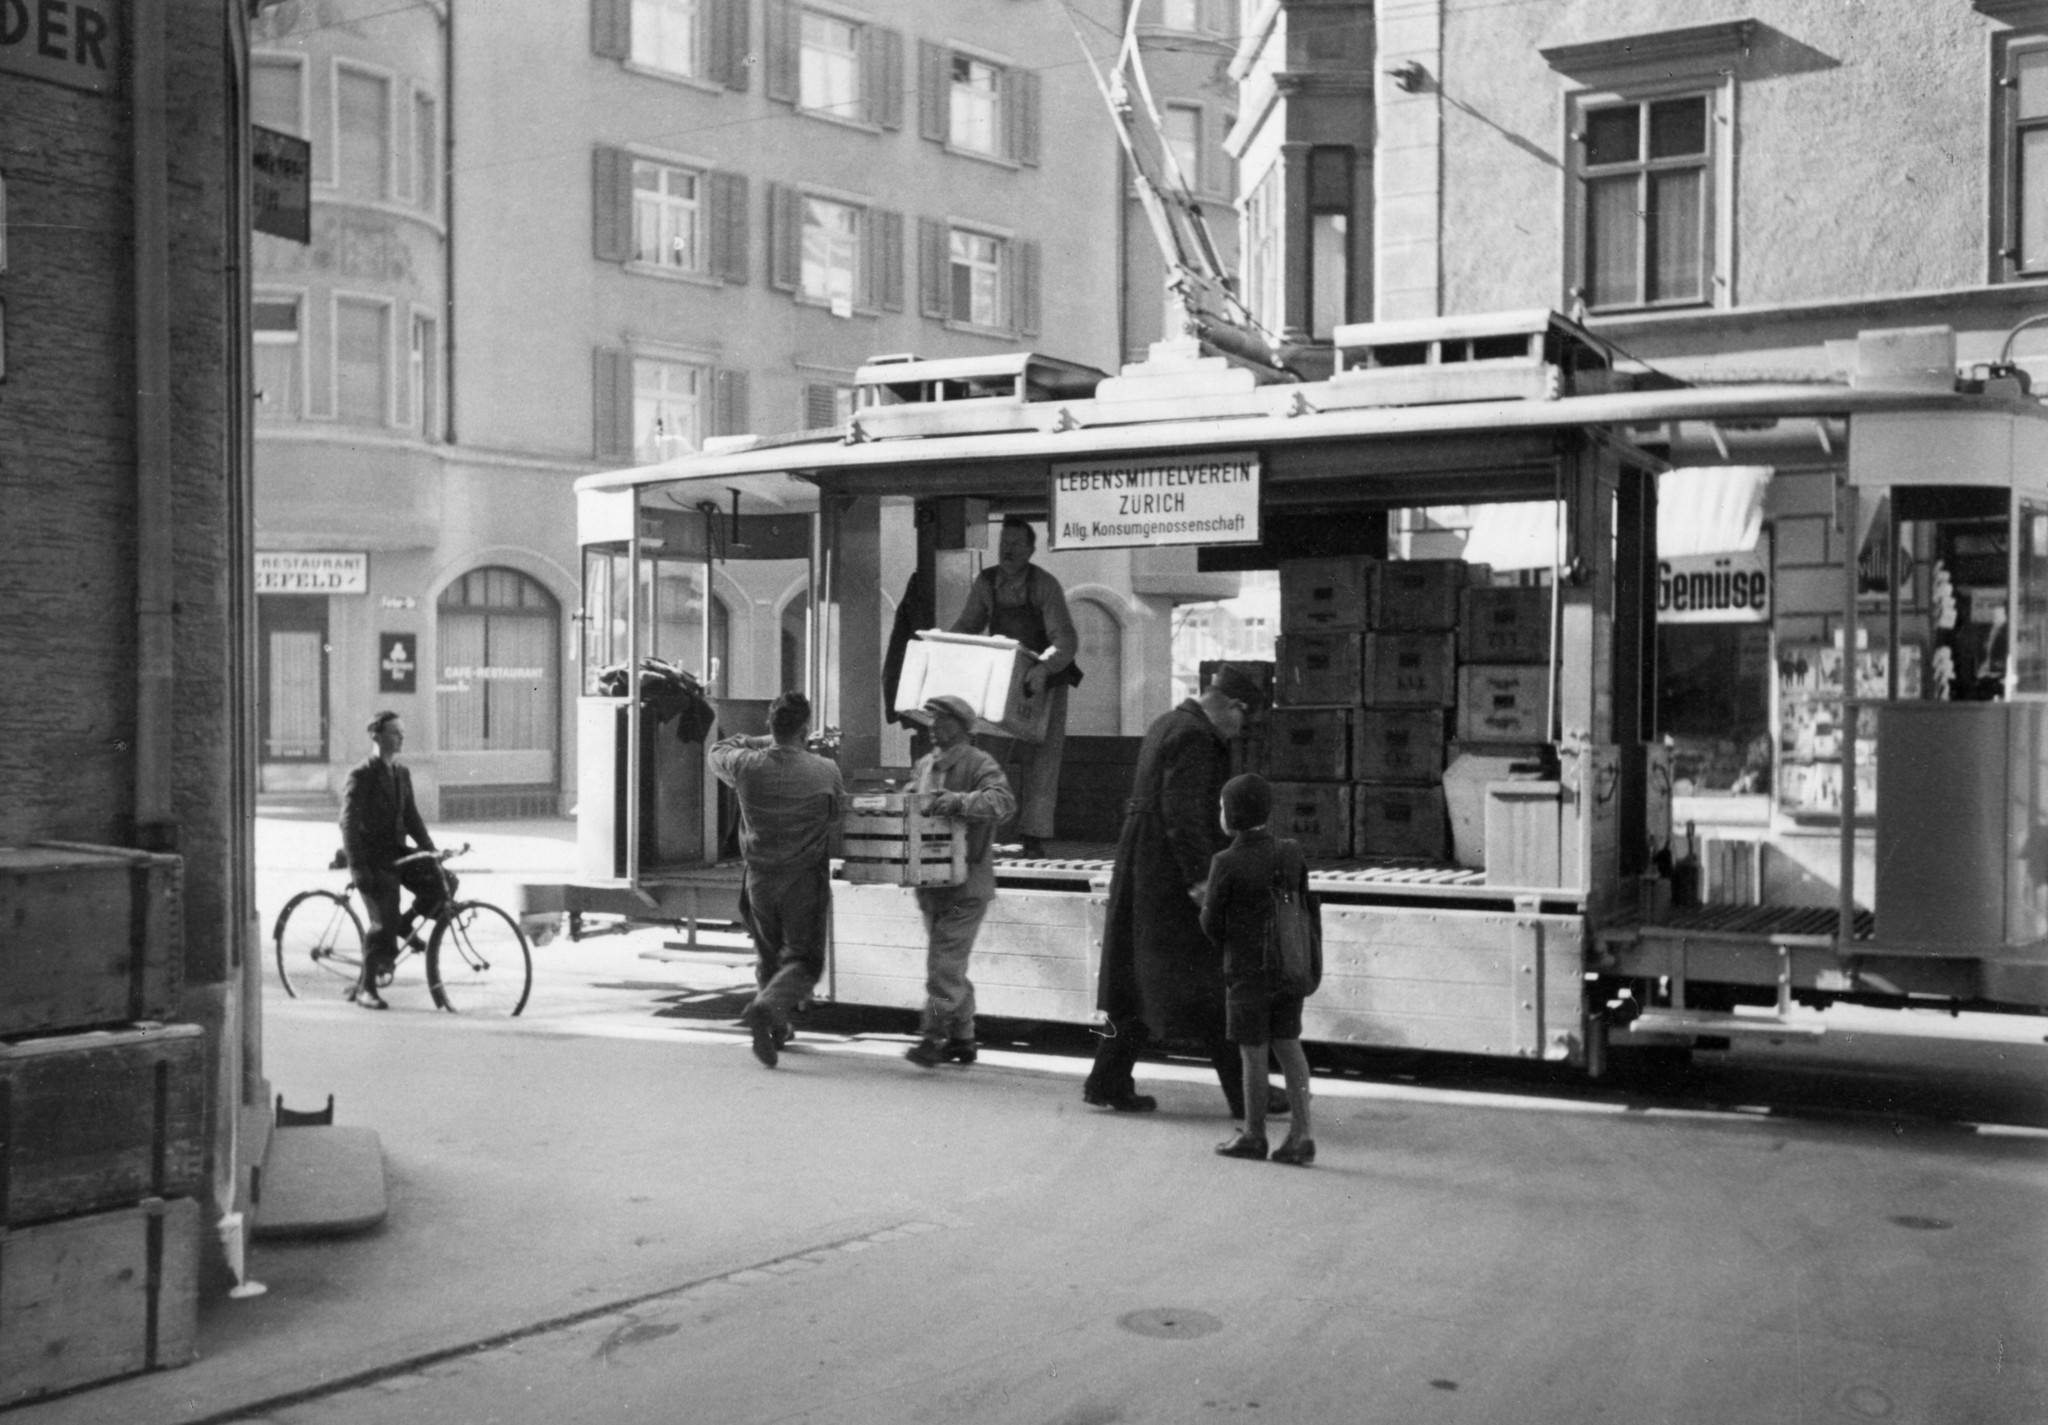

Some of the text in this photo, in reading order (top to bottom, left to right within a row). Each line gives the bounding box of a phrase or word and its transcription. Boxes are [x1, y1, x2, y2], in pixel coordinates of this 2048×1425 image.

[0, 0, 108, 70] DER
[1059, 461, 1251, 492] LEBENSMITTELVEREIN
[1119, 492, 1185, 515] ZÜRICH
[1092, 514, 1245, 538] Konsumgenossenschaft
[262, 558, 361, 569] RESTAURANT
[1657, 559, 1766, 611] Gemüse
